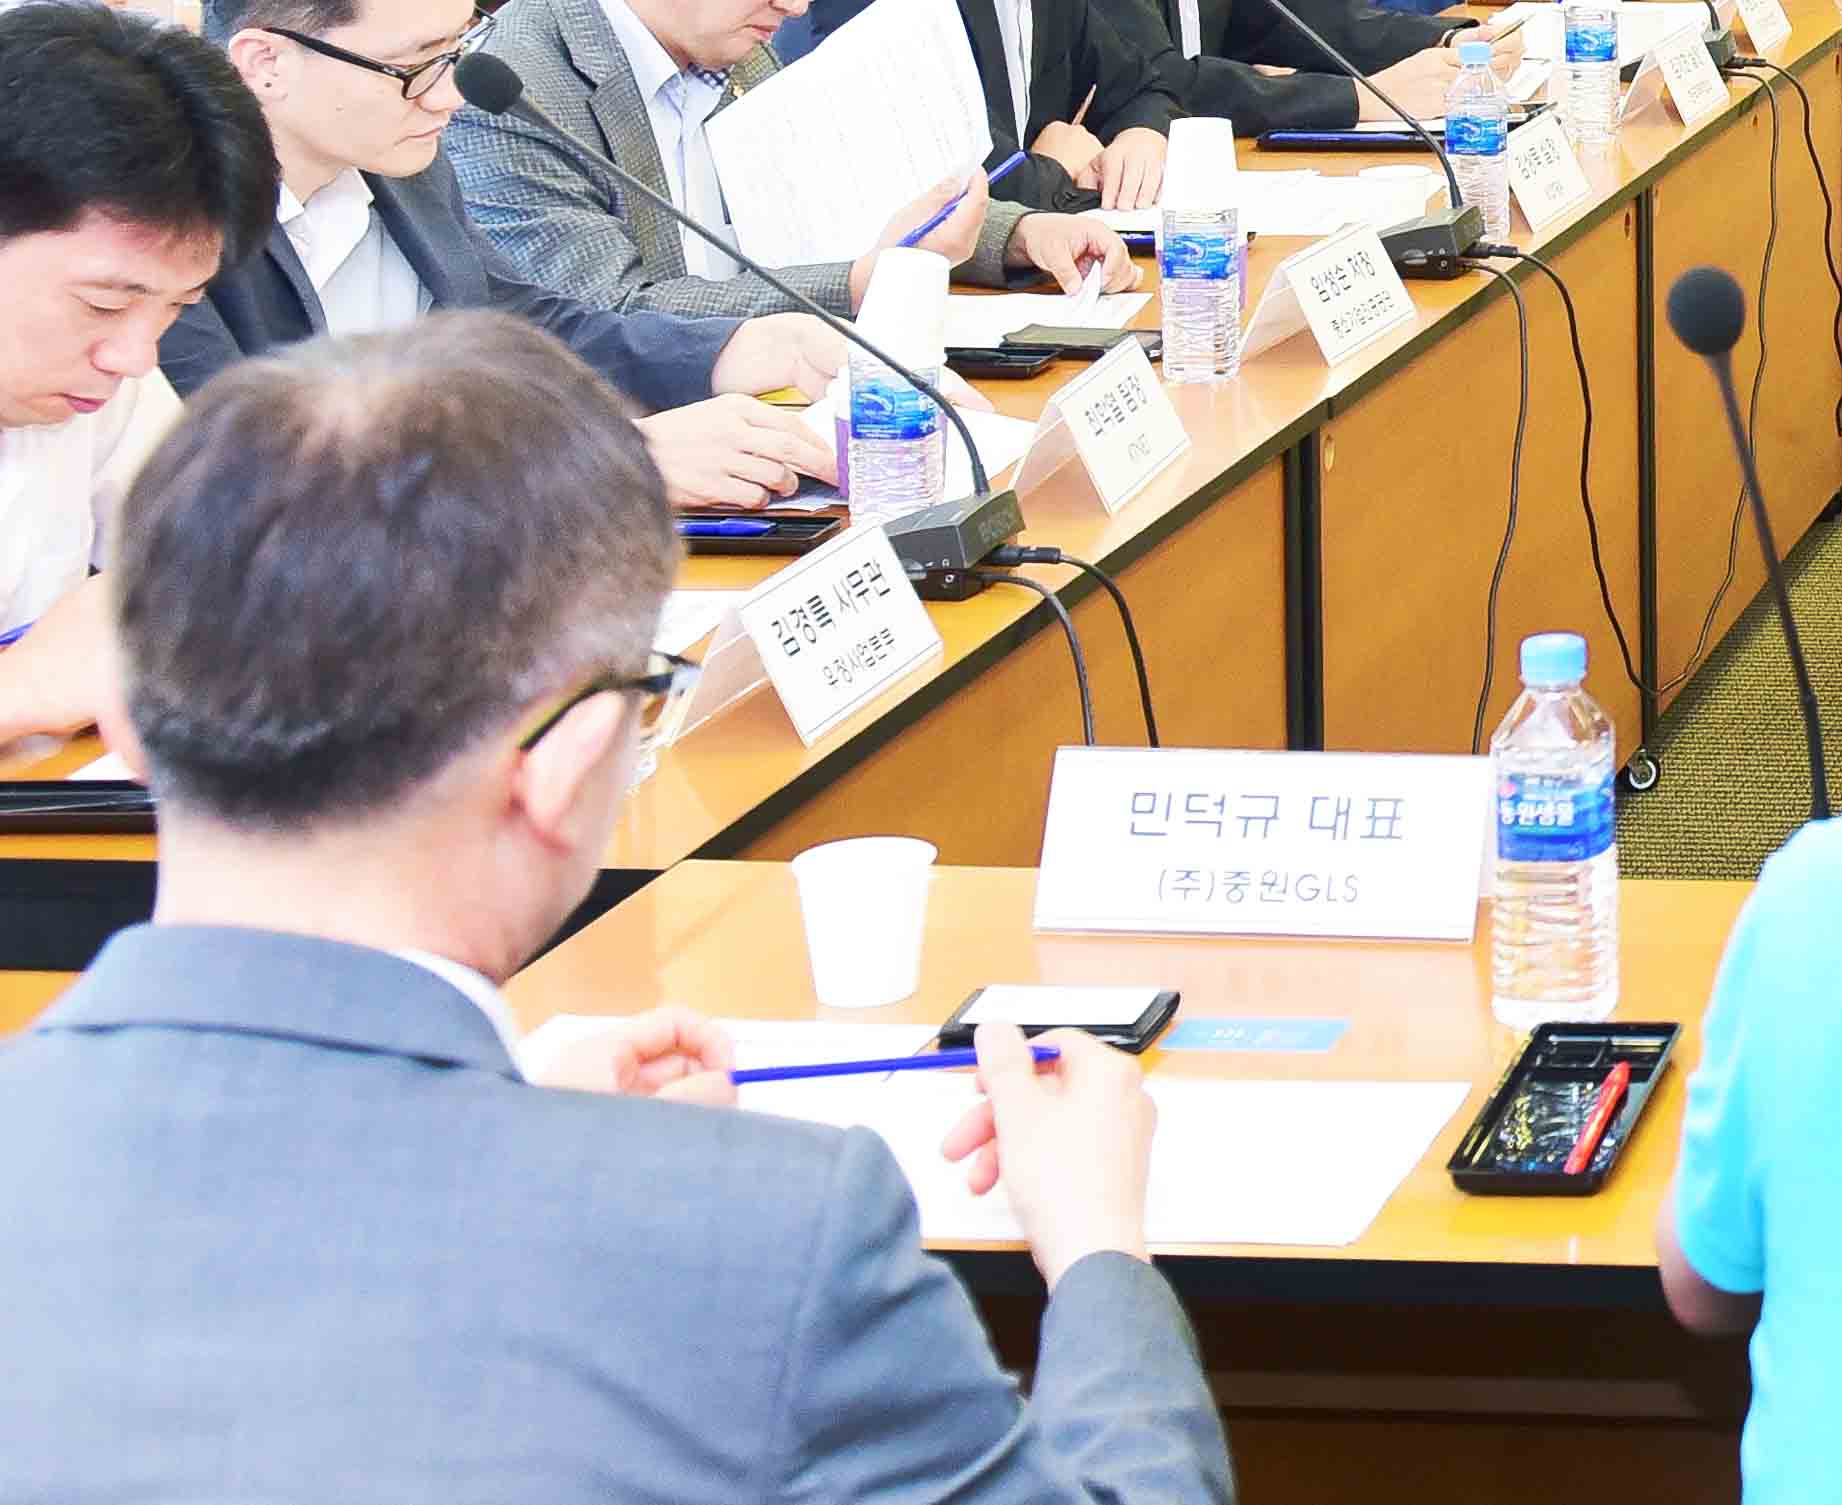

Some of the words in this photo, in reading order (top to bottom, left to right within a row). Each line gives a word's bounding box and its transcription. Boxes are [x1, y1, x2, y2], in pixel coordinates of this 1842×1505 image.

[831, 558, 892, 614] 사무관
[822, 627, 896, 687] 우정사업본부
[1130, 791, 1280, 839] 민덕규
[1309, 796, 1404, 840] 대표
[1158, 869, 1360, 904] (주)중원GLS
